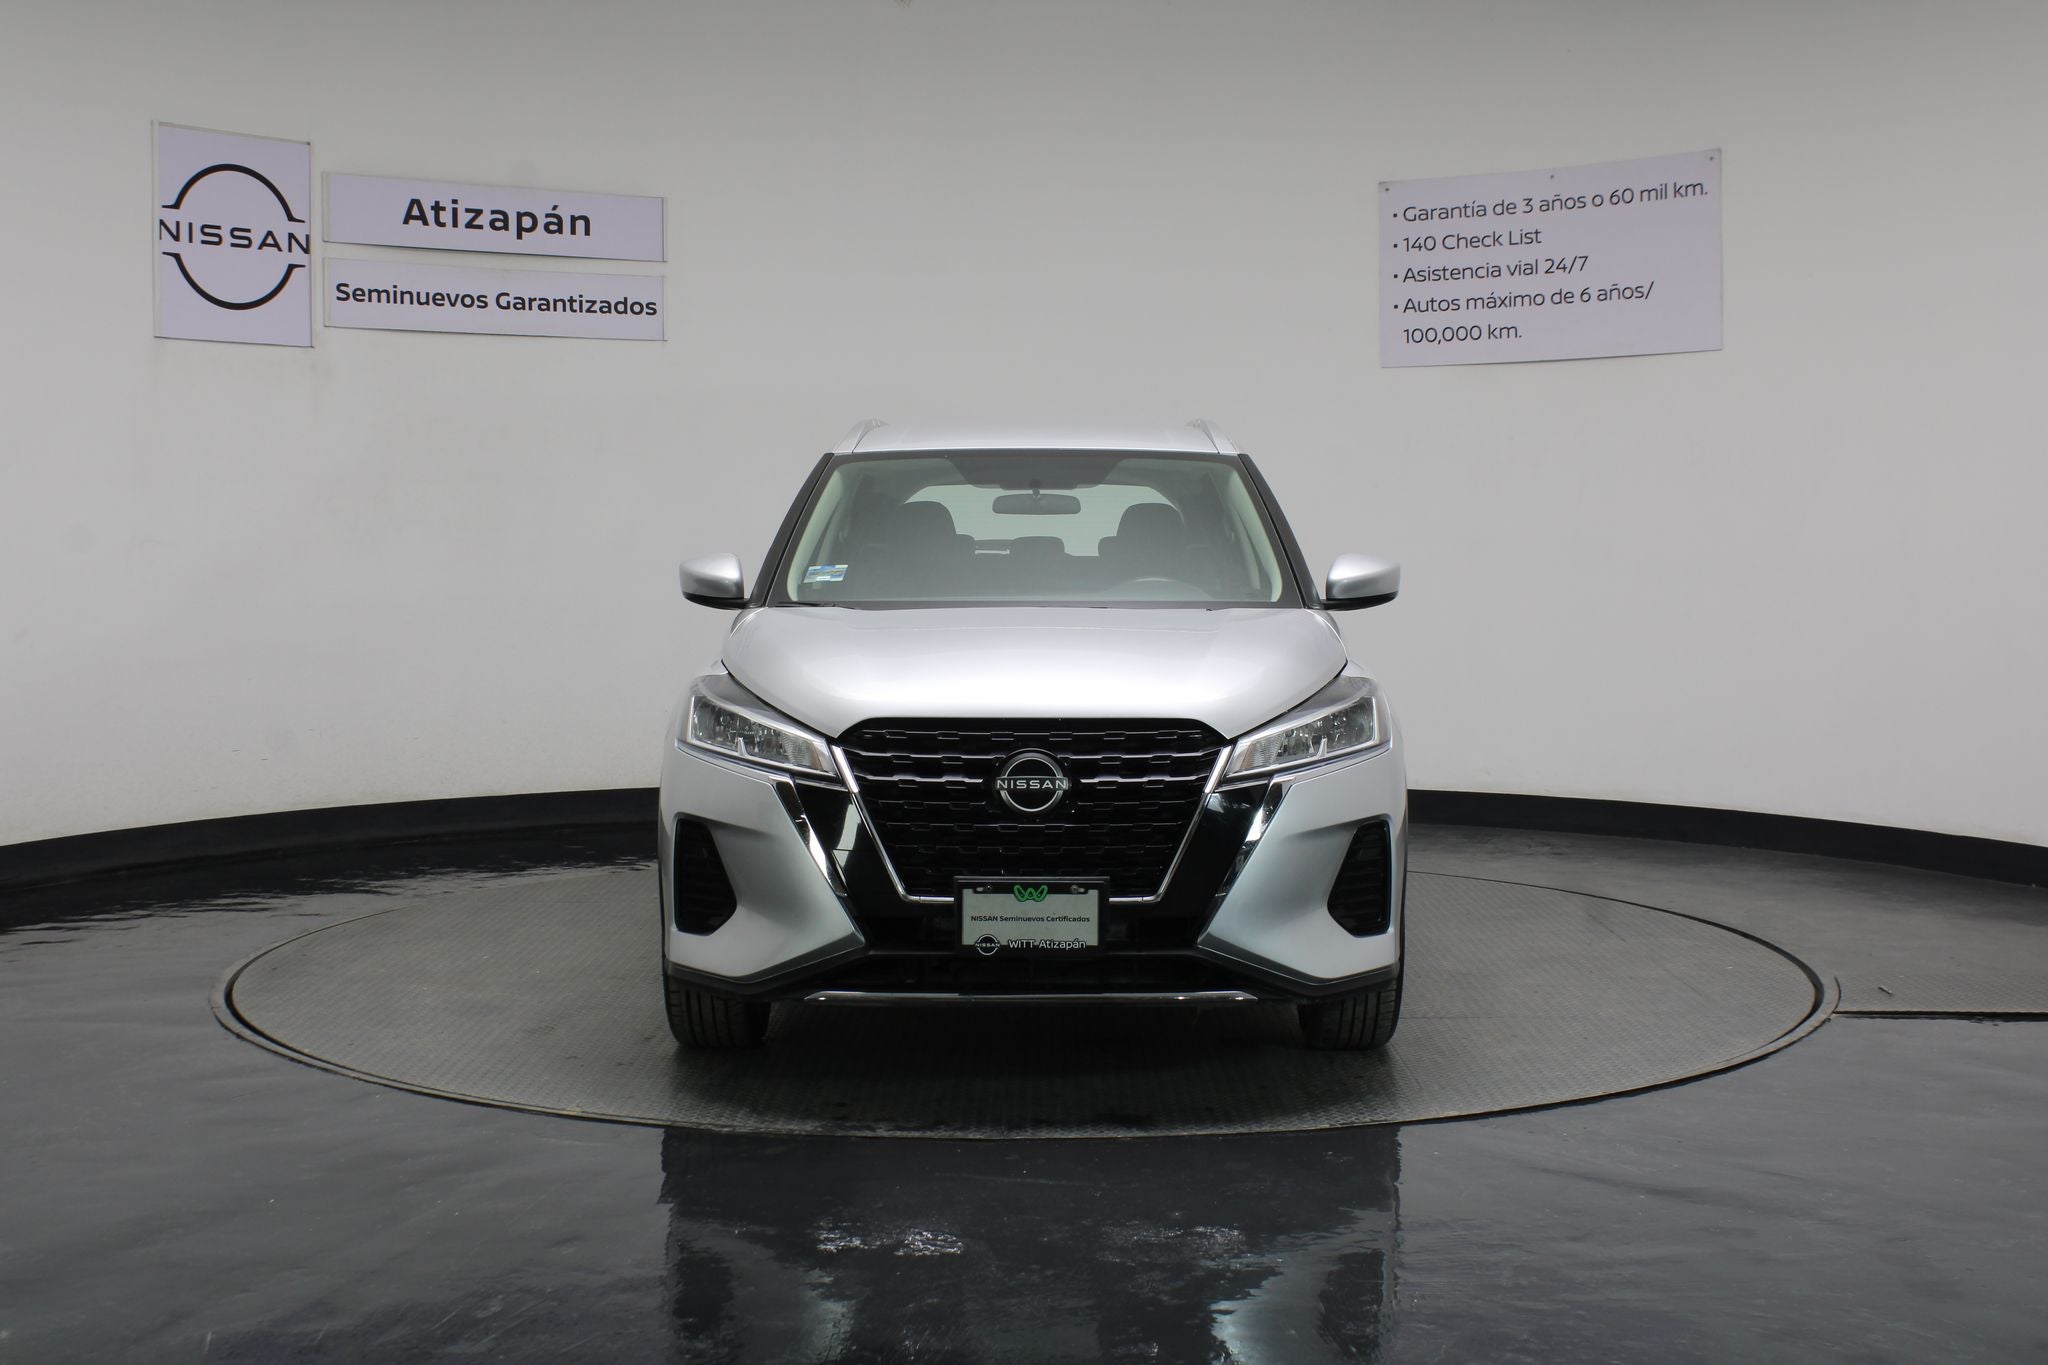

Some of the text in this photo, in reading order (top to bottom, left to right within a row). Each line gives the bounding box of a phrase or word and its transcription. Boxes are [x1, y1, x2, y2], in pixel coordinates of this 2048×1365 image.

[1403, 181, 1709, 223] Garantía de 3 años o 60 mil km.
[402, 198, 591, 241] Atizapán
[159, 218, 311, 255] NISSAN
[1402, 228, 1543, 253] 140 Check List
[1402, 255, 1589, 284] Asistencia vial 24/7
[335, 282, 658, 316] Seminuevos Garantizados
[1402, 280, 1655, 314] Autos máximo de 6 años/
[1402, 323, 1523, 345] 100,000 km.
[996, 779, 1067, 789] NISSAN
[999, 915, 1045, 923] Seminuevos
[1046, 914, 1090, 923] Certificados
[1008, 937, 1086, 951] WITT Atizapán
